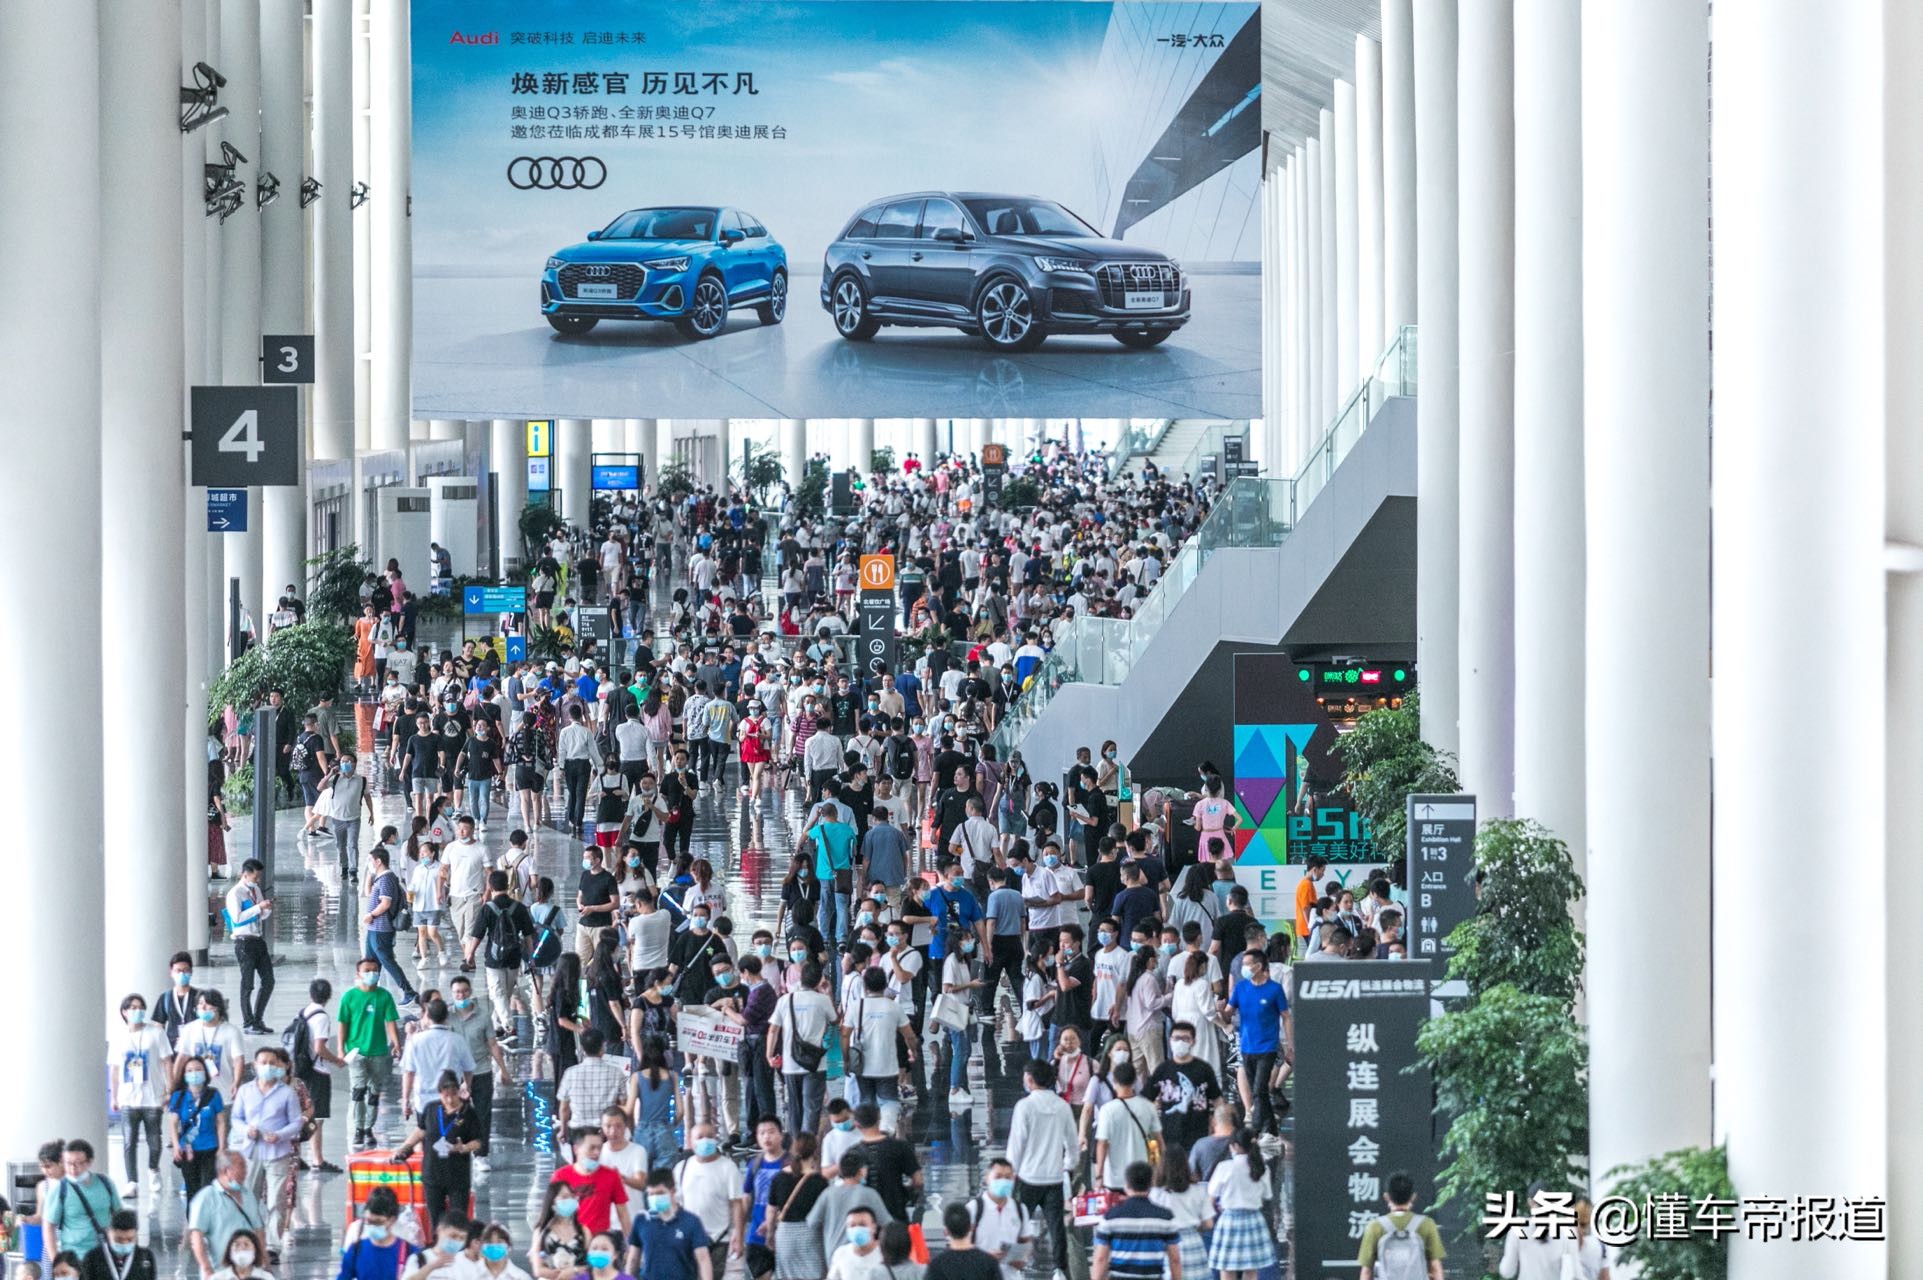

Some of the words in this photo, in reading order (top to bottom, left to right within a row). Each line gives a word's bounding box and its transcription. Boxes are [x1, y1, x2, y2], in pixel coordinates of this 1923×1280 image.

[449, 31, 499, 45] Audi
[510, 32, 574, 45] 突破科技
[582, 32, 647, 45] 启迪未来
[511, 72, 630, 95] 焕新感官
[641, 72, 760, 95] 历见不凡
[511, 124, 788, 140] 邀您莅临成都车展15号馆奥迪展台
[277, 346, 298, 373] 3
[218, 409, 265, 462] 4
[208, 493, 237, 502] 城超市
[1421, 824, 1445, 836] 展厅
[1421, 871, 1444, 882] 入口
[1421, 893, 1432, 907] B
